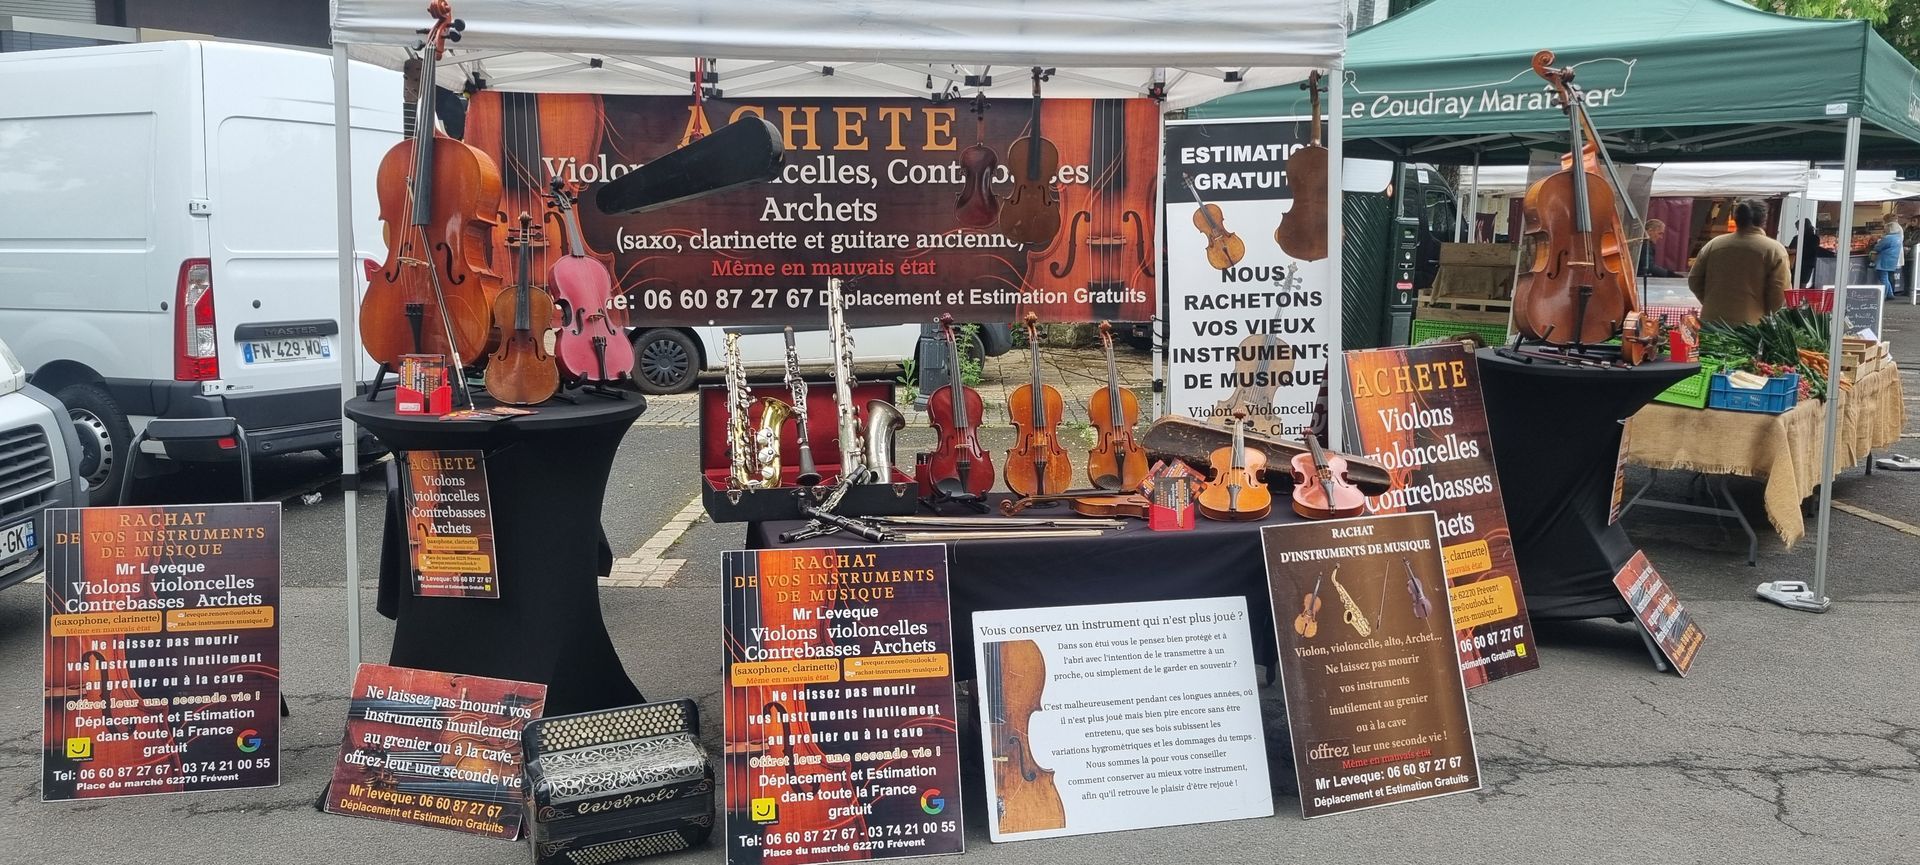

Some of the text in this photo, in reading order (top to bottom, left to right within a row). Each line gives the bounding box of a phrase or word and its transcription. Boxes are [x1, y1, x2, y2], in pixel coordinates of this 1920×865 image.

[1342, 85, 1612, 120] e Coudray Maraîer
[759, 193, 878, 221] Archets
[617, 226, 682, 254] (saxo,
[690, 228, 796, 250] clarinette
[804, 230, 824, 249] et
[830, 231, 909, 253] guitare
[711, 259, 936, 276] Même en mauvais état
[1222, 266, 1285, 283] NOUS
[644, 290, 675, 310] 06
[680, 290, 711, 309] 60
[716, 290, 746, 309] 87
[751, 290, 778, 308] 27
[786, 289, 813, 308] 67
[819, 290, 942, 308] Dplacement
[947, 291, 963, 305] et
[970, 289, 1067, 305] Estimation
[1073, 288, 1146, 303] Gratuits
[1184, 291, 1322, 311] RACHETONS
[265, 326, 318, 336] MASTER
[1192, 318, 1315, 336] VOS VIEUX
[1173, 343, 1328, 363] INSTRUMENTS
[1184, 370, 1323, 389] DE MUSIQUE
[1354, 360, 1467, 399] ACHETE
[1189, 402, 1315, 417] Violon Violoncell
[1379, 402, 1454, 433] Violons
[411, 457, 475, 470] ACHETE
[423, 474, 465, 486] Violons
[414, 490, 479, 502] violoncelles
[120, 512, 206, 527] RACHAT
[412, 506, 486, 518] Contrebasses
[430, 522, 471, 534] Archets
[1331, 525, 1374, 539] RACHAT
[1437, 513, 1474, 538] hets
[56, 527, 266, 545] DE VOS INSTRUMENTS
[102, 544, 223, 558] DE MUSIQUE
[1280, 539, 1431, 562] D'INSTRUMENTS DE MUSIQUE
[1451, 545, 1487, 561] clarinette)
[116, 562, 205, 575] Mr Leveque
[72, 575, 254, 595] Violons violoncelles
[1458, 589, 1475, 599] 62270
[65, 591, 262, 613] Contrebasses Archets
[980, 611, 1243, 636] Vous conservez un instrument qui n'est plus joué ?
[1294, 632, 1442, 659] Violon, violoncelle, alto, Archet...
[1460, 625, 1524, 652] 06 60 87 27 67
[1491, 649, 1515, 661] Gratuits
[734, 662, 838, 675] (saxophone, clarinette)
[746, 676, 770, 684] Même
[366, 686, 532, 719] Ne laissez pas mourir vos
[364, 708, 443, 730] instruments
[364, 732, 514, 765] au grenier ou à la cave,
[794, 754, 821, 765] leur
[826, 753, 850, 763] une
[855, 748, 908, 761] seconde
[912, 746, 932, 758] vie
[936, 746, 940, 756] !
[344, 750, 522, 788] offrez-leur une seconde vie
[124, 778, 163, 788] marché
[167, 776, 197, 784] 62270
[201, 773, 239, 782] Frévent
[1082, 792, 1097, 800] afin
[1099, 790, 1116, 800] qu'il
[1118, 787, 1150, 797] retrouve
[1160, 783, 1185, 794] plaisir
[1187, 782, 1208, 791] d'être
[1209, 781, 1233, 790] rejoué
[349, 784, 502, 818] Mr leveque: 06 60 87 27 67
[578, 788, 678, 814] Cavagnolo
